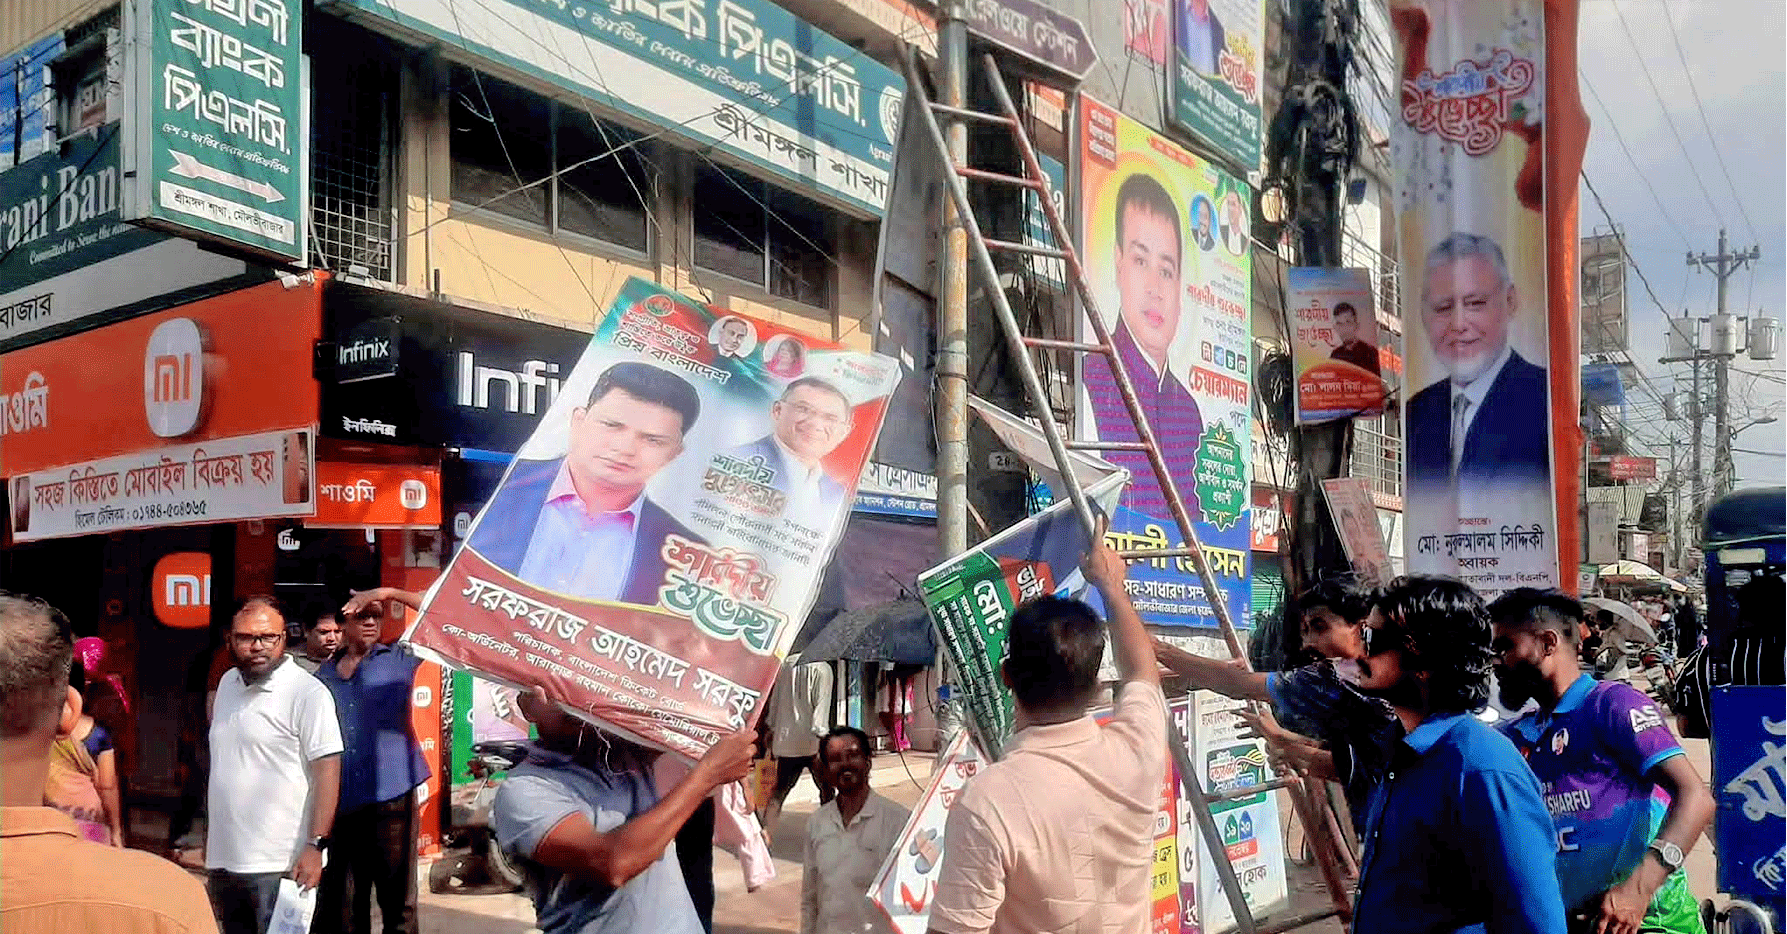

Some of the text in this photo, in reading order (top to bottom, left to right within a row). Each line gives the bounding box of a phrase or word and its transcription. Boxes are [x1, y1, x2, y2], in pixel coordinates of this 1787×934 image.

[171, 11, 284, 88] ব্যাংক
[1033, 15, 1079, 65] স্টেশন
[713, 102, 886, 203] শ্রীমঙ্গল শাখা
[173, 188, 206, 212] শ্রীমঙ্গল
[233, 209, 284, 235] মৌলভীবাজার
[338, 338, 390, 364] Infinix
[613, 330, 731, 384] প্রিয় বাংলাদেশ
[1189, 364, 1248, 406] চেয়ারম্যান
[34, 447, 275, 511] সহজ কিস্তিতে মোবাইল বিক্রয় হয়
[320, 479, 376, 503] শাওমি
[713, 454, 775, 485] শারদীয়
[1500, 523, 1545, 552] সিদ্দিকী
[668, 539, 774, 601] শারদীয়
[1123, 579, 1186, 600] সহ-সাধারণ
[665, 574, 782, 651] শুভেচ্ছা
[1132, 599, 1178, 614] মৌলভীবাজার
[462, 575, 589, 645] সরফরাজ
[590, 624, 691, 689] আহমেদ
